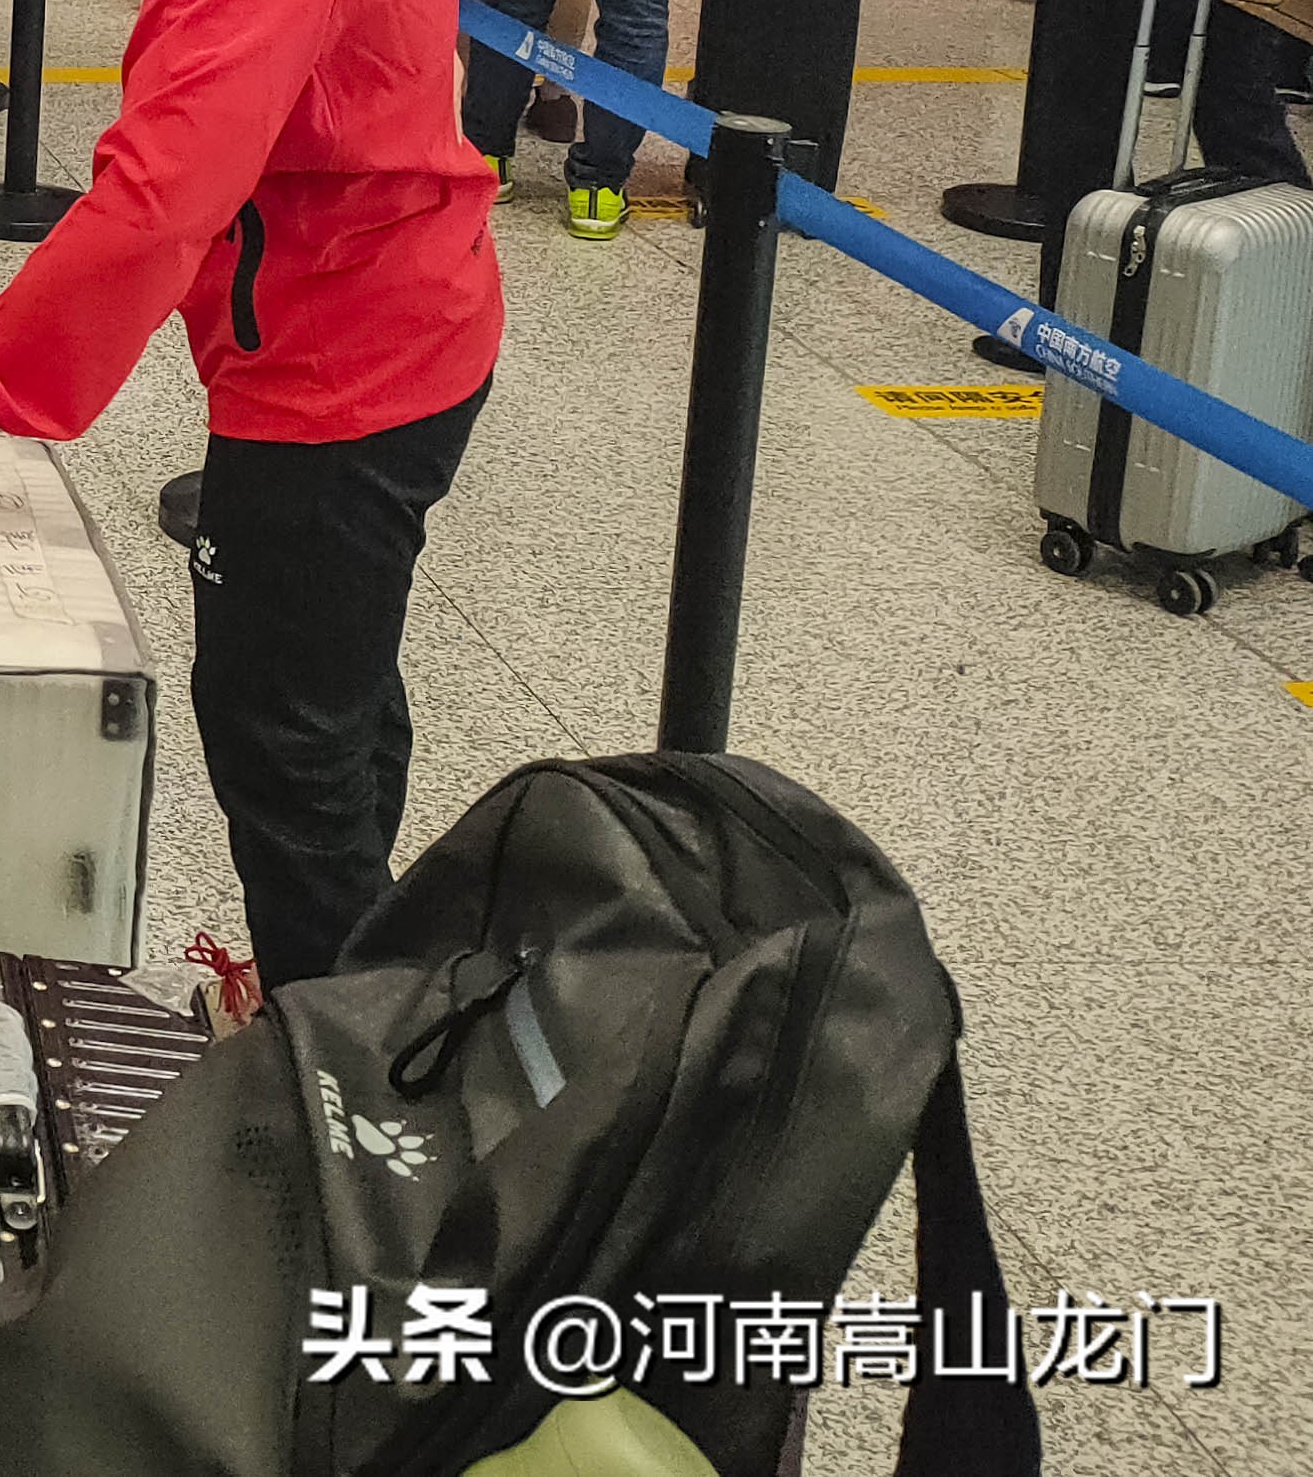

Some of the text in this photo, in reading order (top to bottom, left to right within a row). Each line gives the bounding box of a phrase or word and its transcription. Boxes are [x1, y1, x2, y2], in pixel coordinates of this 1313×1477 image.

[1036, 321, 1123, 383] 中国南方航空
[316, 1069, 355, 1160] KELME
